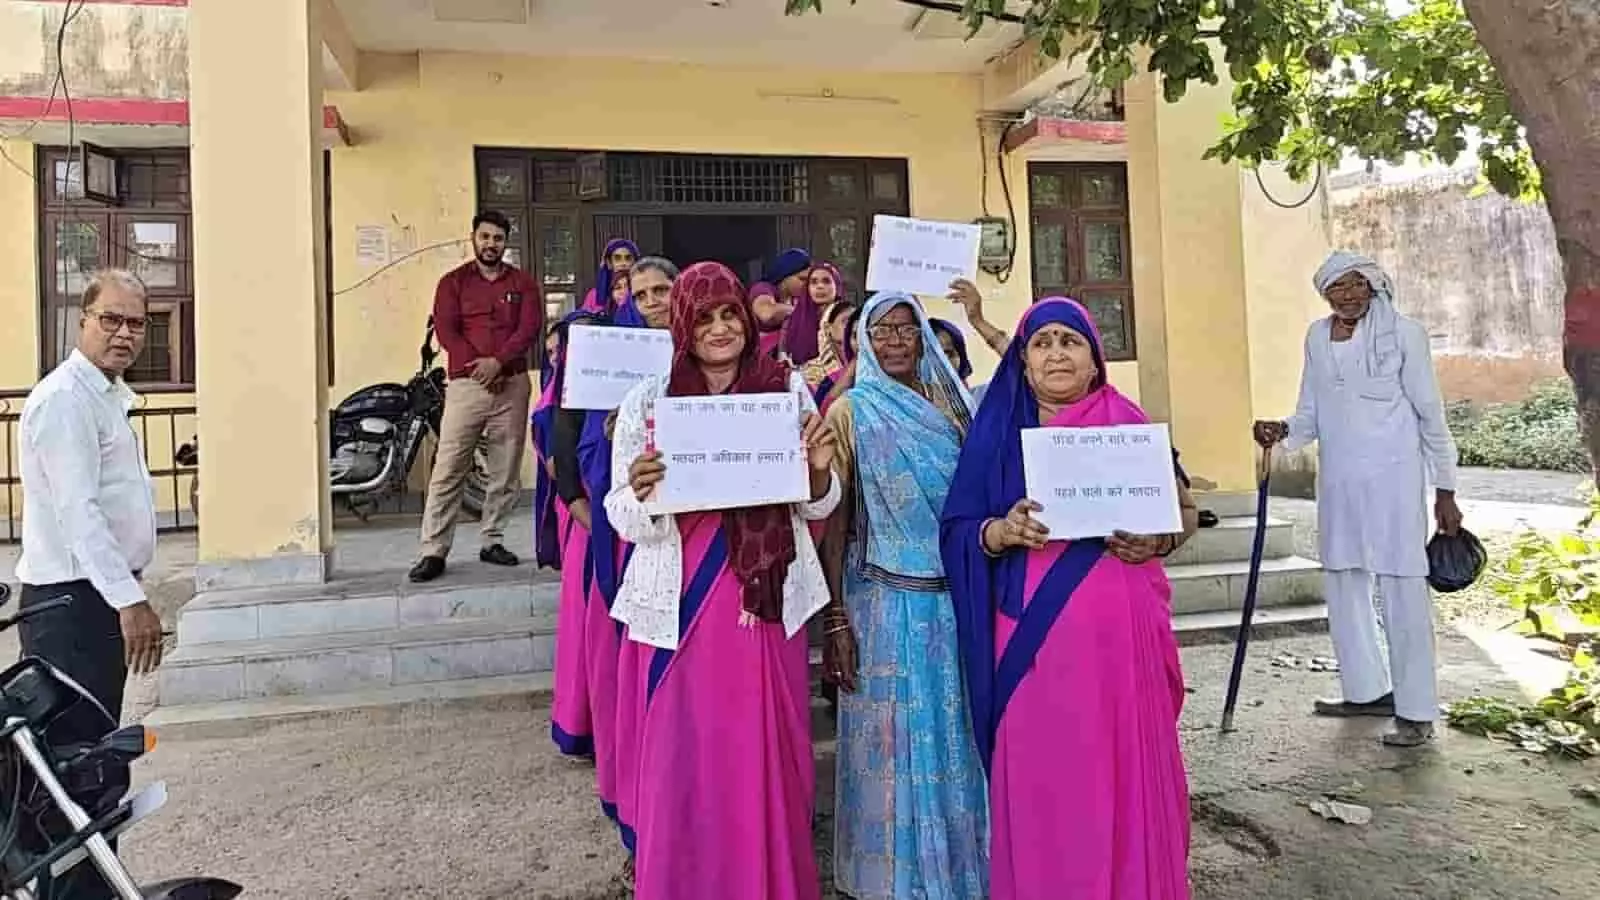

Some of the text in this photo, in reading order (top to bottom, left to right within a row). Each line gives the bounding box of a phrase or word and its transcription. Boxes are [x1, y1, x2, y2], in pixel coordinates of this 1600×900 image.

[672, 453, 706, 464] मतदान
[711, 449, 752, 464] अधिकार
[1128, 486, 1161, 496] मतदान
